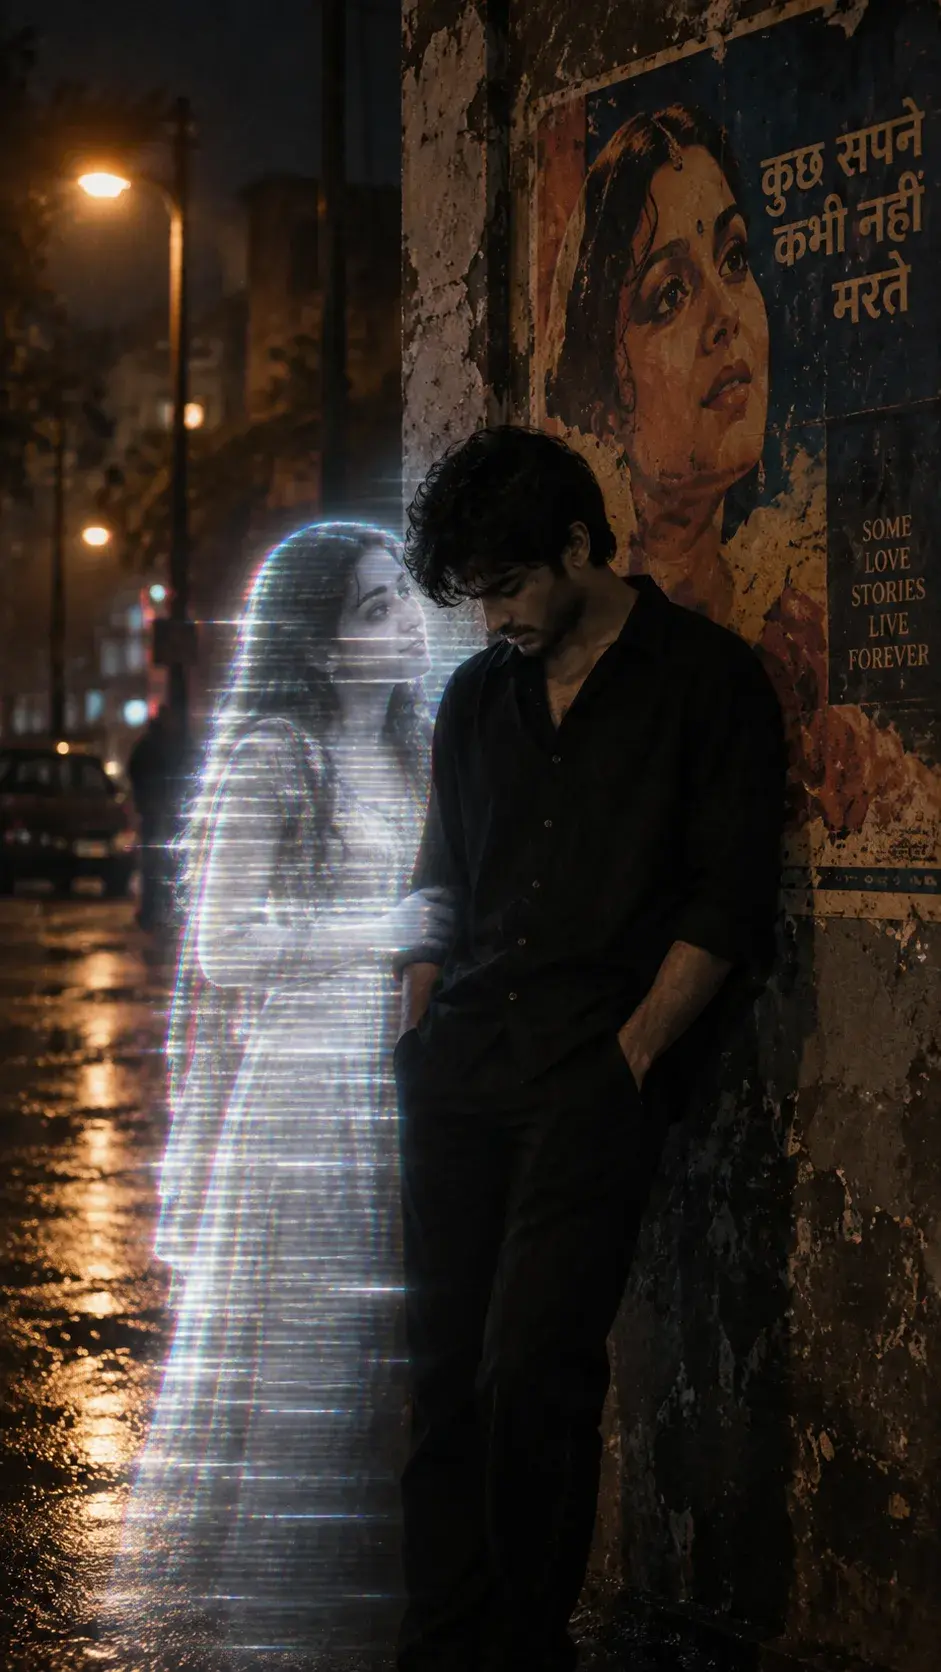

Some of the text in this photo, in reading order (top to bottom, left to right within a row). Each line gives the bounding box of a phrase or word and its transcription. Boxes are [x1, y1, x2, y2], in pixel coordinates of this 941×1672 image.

[760, 97, 926, 217] कुछ सपने
[773, 170, 926, 266] कभी नहीं
[832, 250, 911, 323] मरते
[862, 515, 912, 542] SOME
[864, 547, 911, 573] LOVE
[851, 578, 926, 607] STORIES
[868, 612, 909, 638] LIVE
[848, 644, 929, 671] FOREVER
